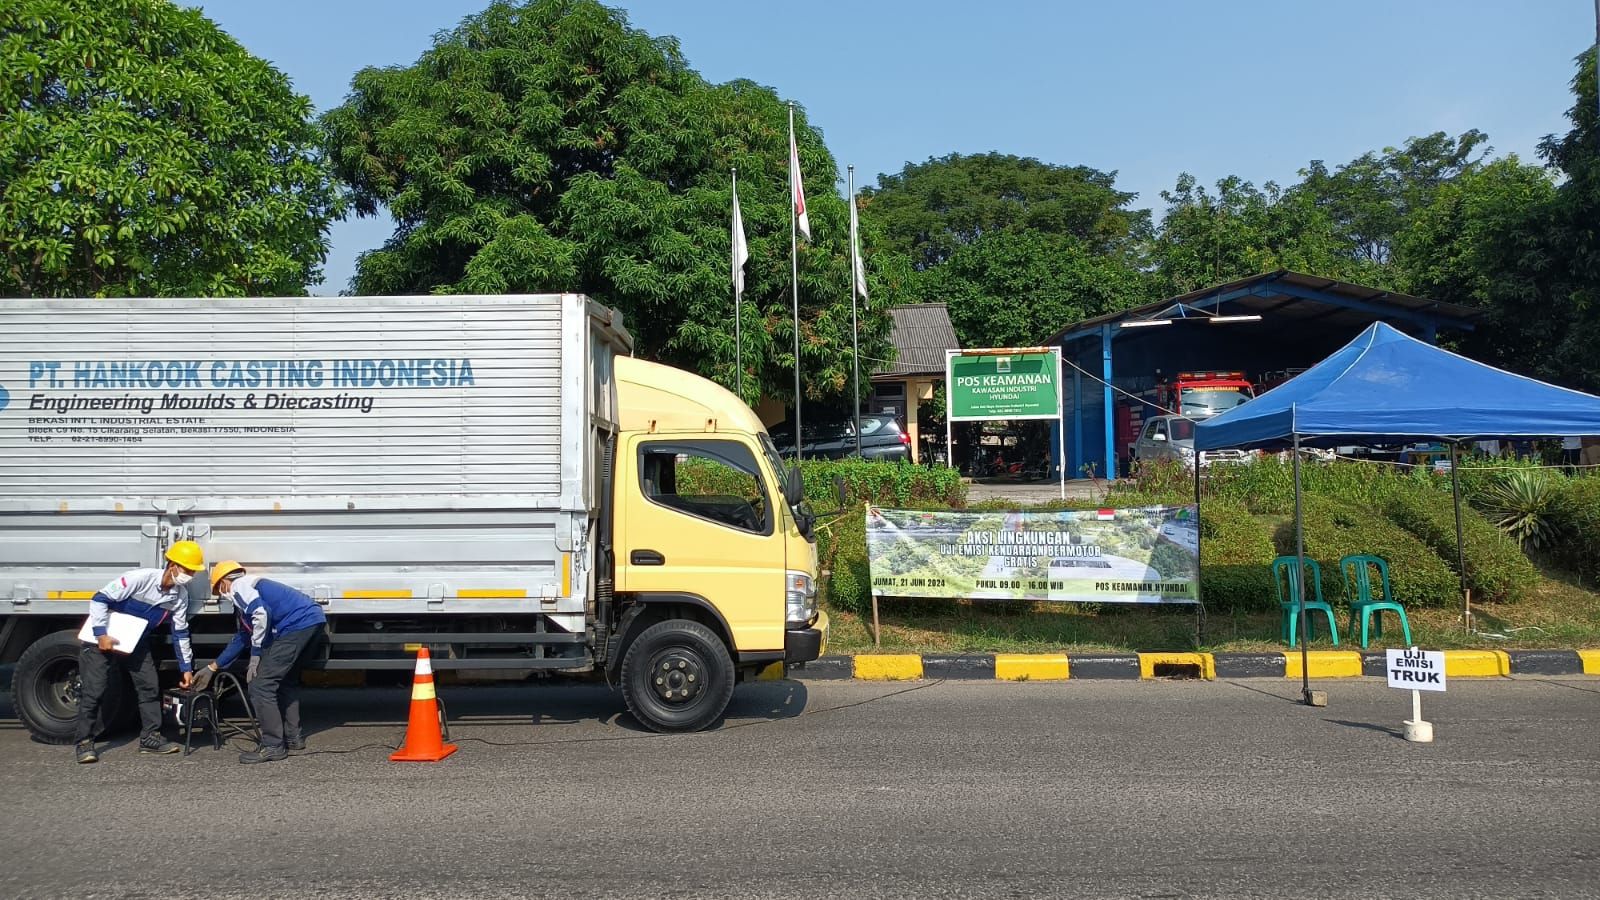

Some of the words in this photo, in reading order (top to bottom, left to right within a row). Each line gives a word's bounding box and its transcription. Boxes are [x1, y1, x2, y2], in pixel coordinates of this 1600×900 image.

[29, 361, 64, 388] PT.
[74, 360, 203, 388] HANKOOK
[211, 359, 323, 388] CASTING
[333, 359, 475, 387] INDONESIA
[957, 376, 980, 386] POS
[983, 374, 1051, 386] KEAMANAN
[1006, 385, 1037, 393] INDUSTRI
[989, 393, 1020, 401] HYUNDAI
[28, 393, 153, 414] Engineering
[160, 393, 235, 410] Moulds
[243, 393, 257, 410] &
[264, 392, 374, 413] Diecasting
[100, 427, 139, 435] Cikarang
[967, 531, 992, 544] AKSI
[997, 531, 1070, 545] LINGKUNGAN
[940, 544, 955, 555] UJI
[958, 544, 985, 556] EMISI
[988, 545, 1047, 557] KENDARAAN
[1048, 545, 1101, 558] BERMOTOR
[1003, 556, 1038, 568] GRATIS
[873, 578, 898, 588] JUMAT,
[900, 578, 908, 587] 21
[910, 578, 926, 587] JUNI
[927, 578, 945, 588] 2024
[976, 580, 997, 589] PUKUL
[999, 580, 1020, 589] 09.00
[1028, 580, 1048, 590] 16.00
[1050, 581, 1064, 590] WIB
[1095, 582, 1109, 591] POS
[1112, 582, 1153, 592] KEAMANAN
[1155, 583, 1188, 593] HYUNDAI
[1403, 650, 1425, 660] UJI
[1396, 658, 1433, 669] EMISI
[1391, 669, 1440, 684] TRUK
